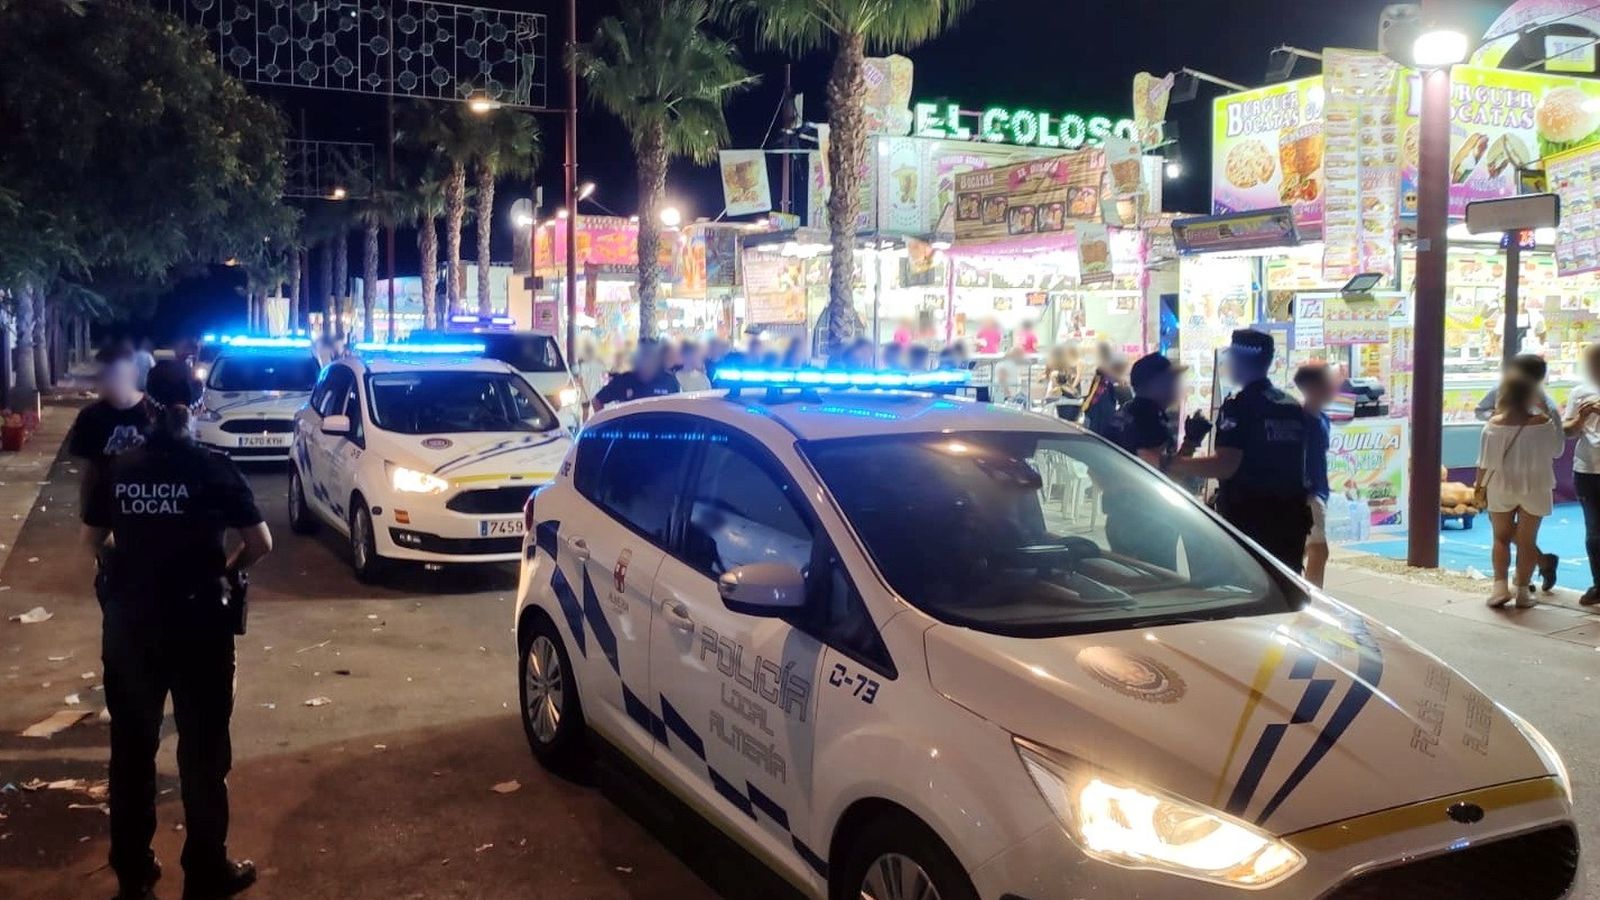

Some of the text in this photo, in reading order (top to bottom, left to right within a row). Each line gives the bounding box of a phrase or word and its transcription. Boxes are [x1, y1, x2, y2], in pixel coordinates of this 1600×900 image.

[914, 102, 1138, 148] EL COLOSO
[1328, 432, 1400, 455] QUILLA
[115, 483, 190, 499] POLICIA
[121, 501, 184, 515] LOCAL
[490, 520, 523, 534] 7459
[700, 625, 811, 723] POLICÍA
[721, 682, 774, 737] LOCAL
